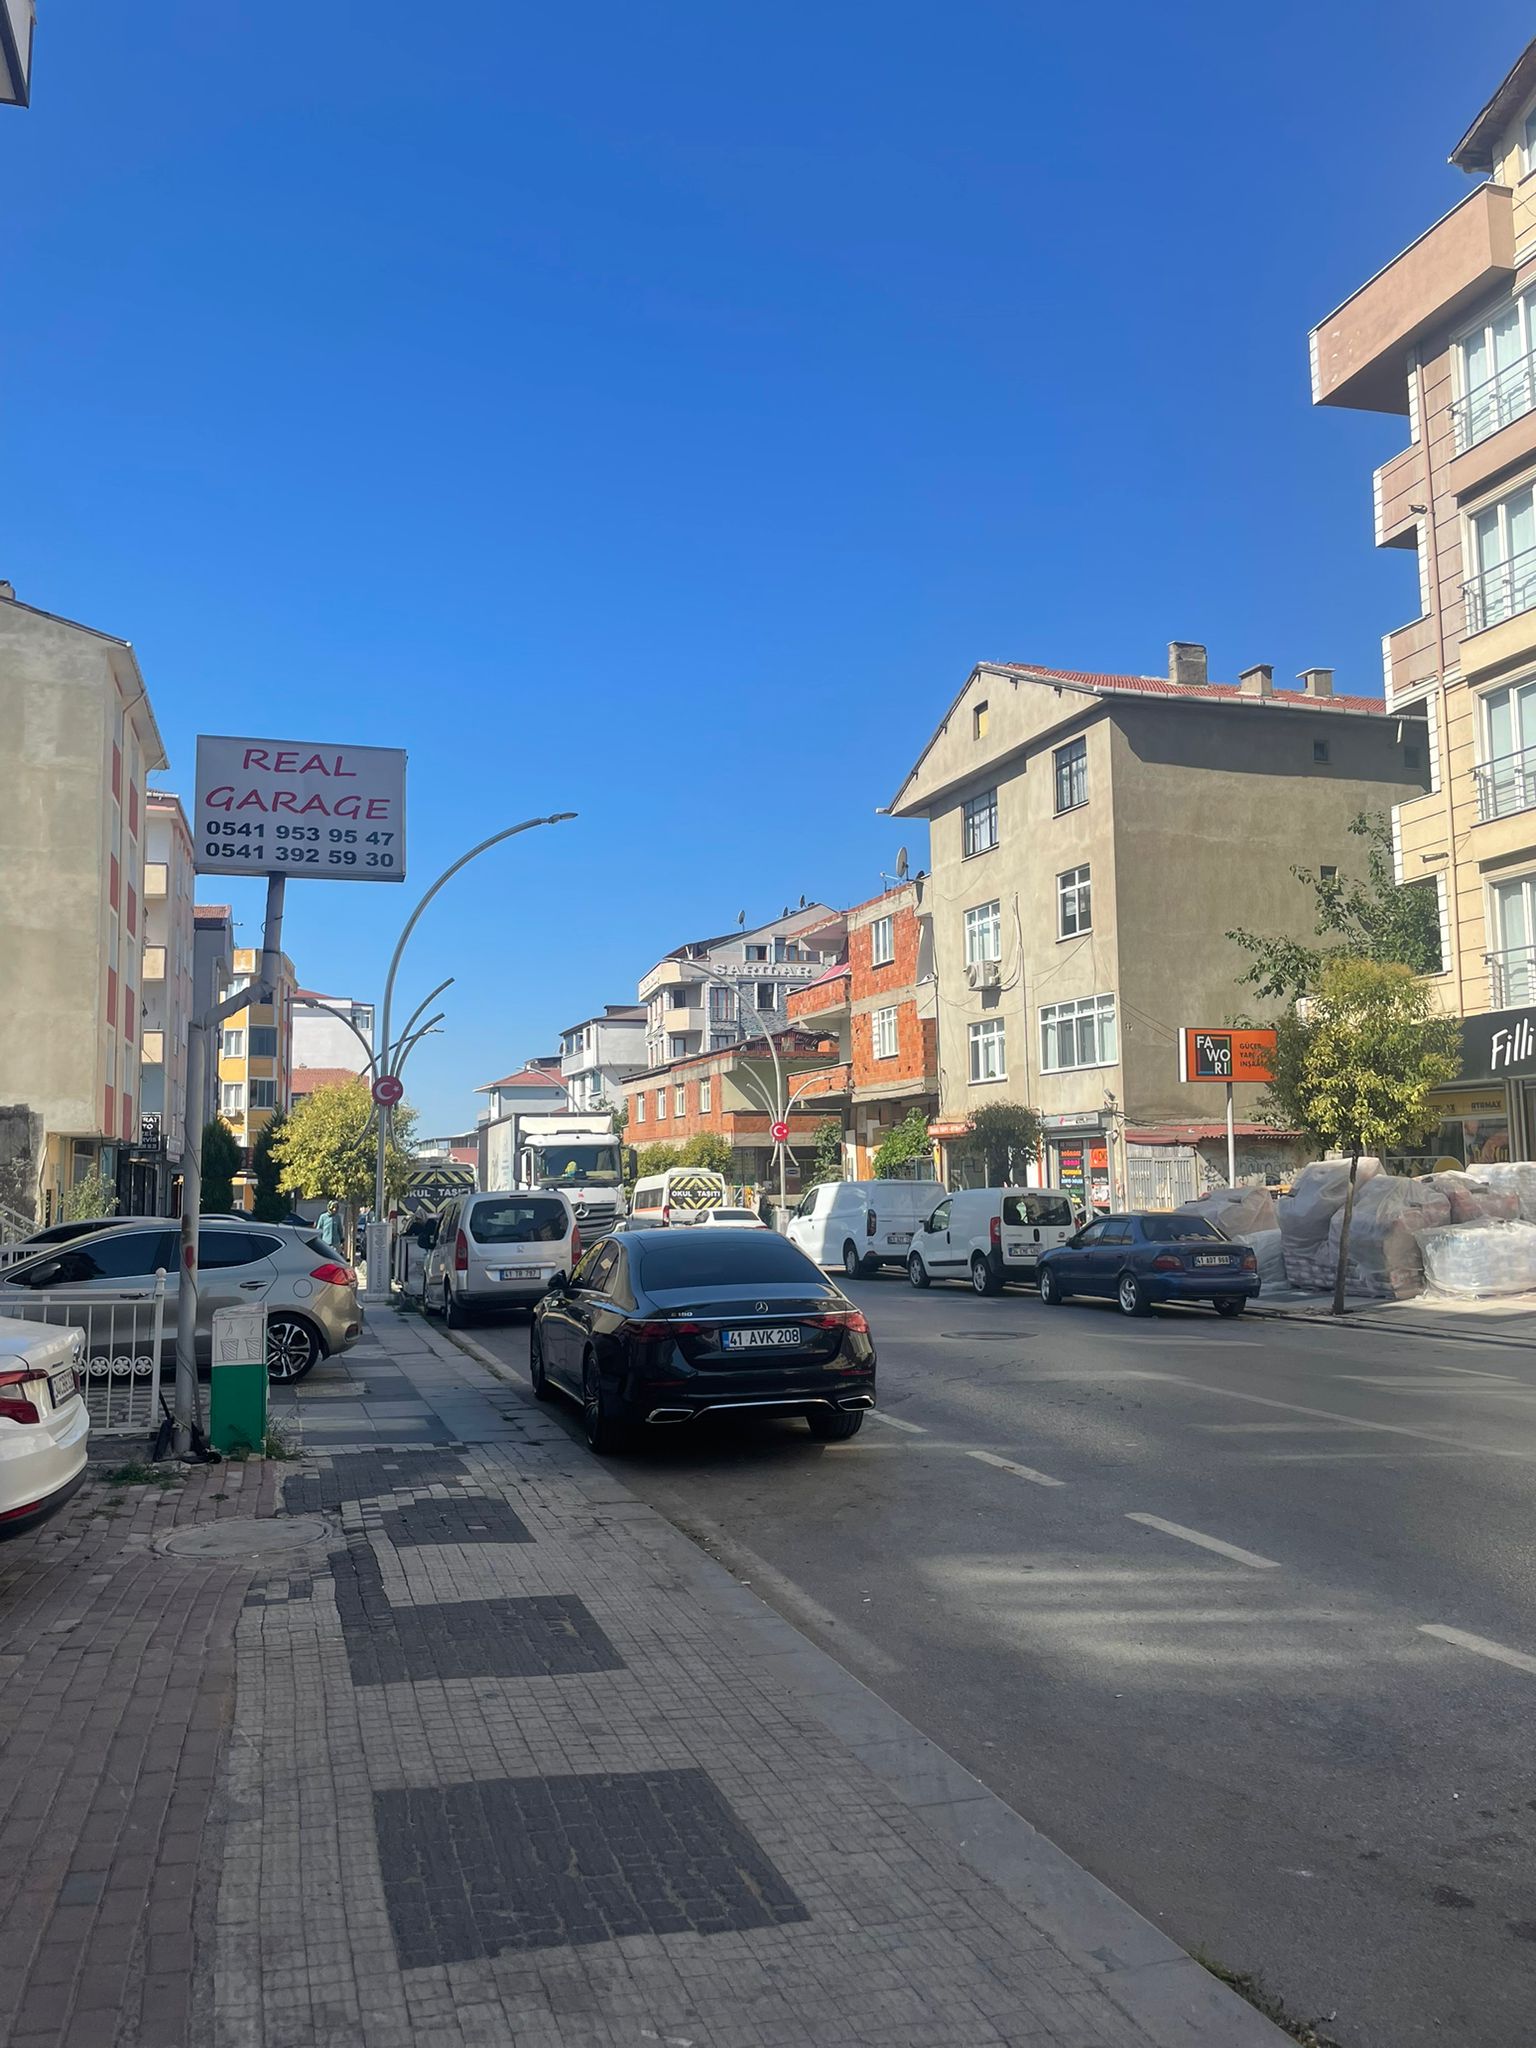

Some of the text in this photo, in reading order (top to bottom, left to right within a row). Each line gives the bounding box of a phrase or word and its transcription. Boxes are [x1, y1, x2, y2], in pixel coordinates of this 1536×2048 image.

[243, 749, 357, 777] REAL
[205, 786, 391, 820] GARAGE
[206, 821, 394, 846] 0541 953 95 47
[205, 842, 394, 868] 0541 392 59 30
[713, 963, 813, 978] SARILAR
[1491, 1018, 1535, 1070] Filli
[697, 1190, 721, 1198] TAŞITI
[729, 1328, 799, 1346] 41 AVK 208
